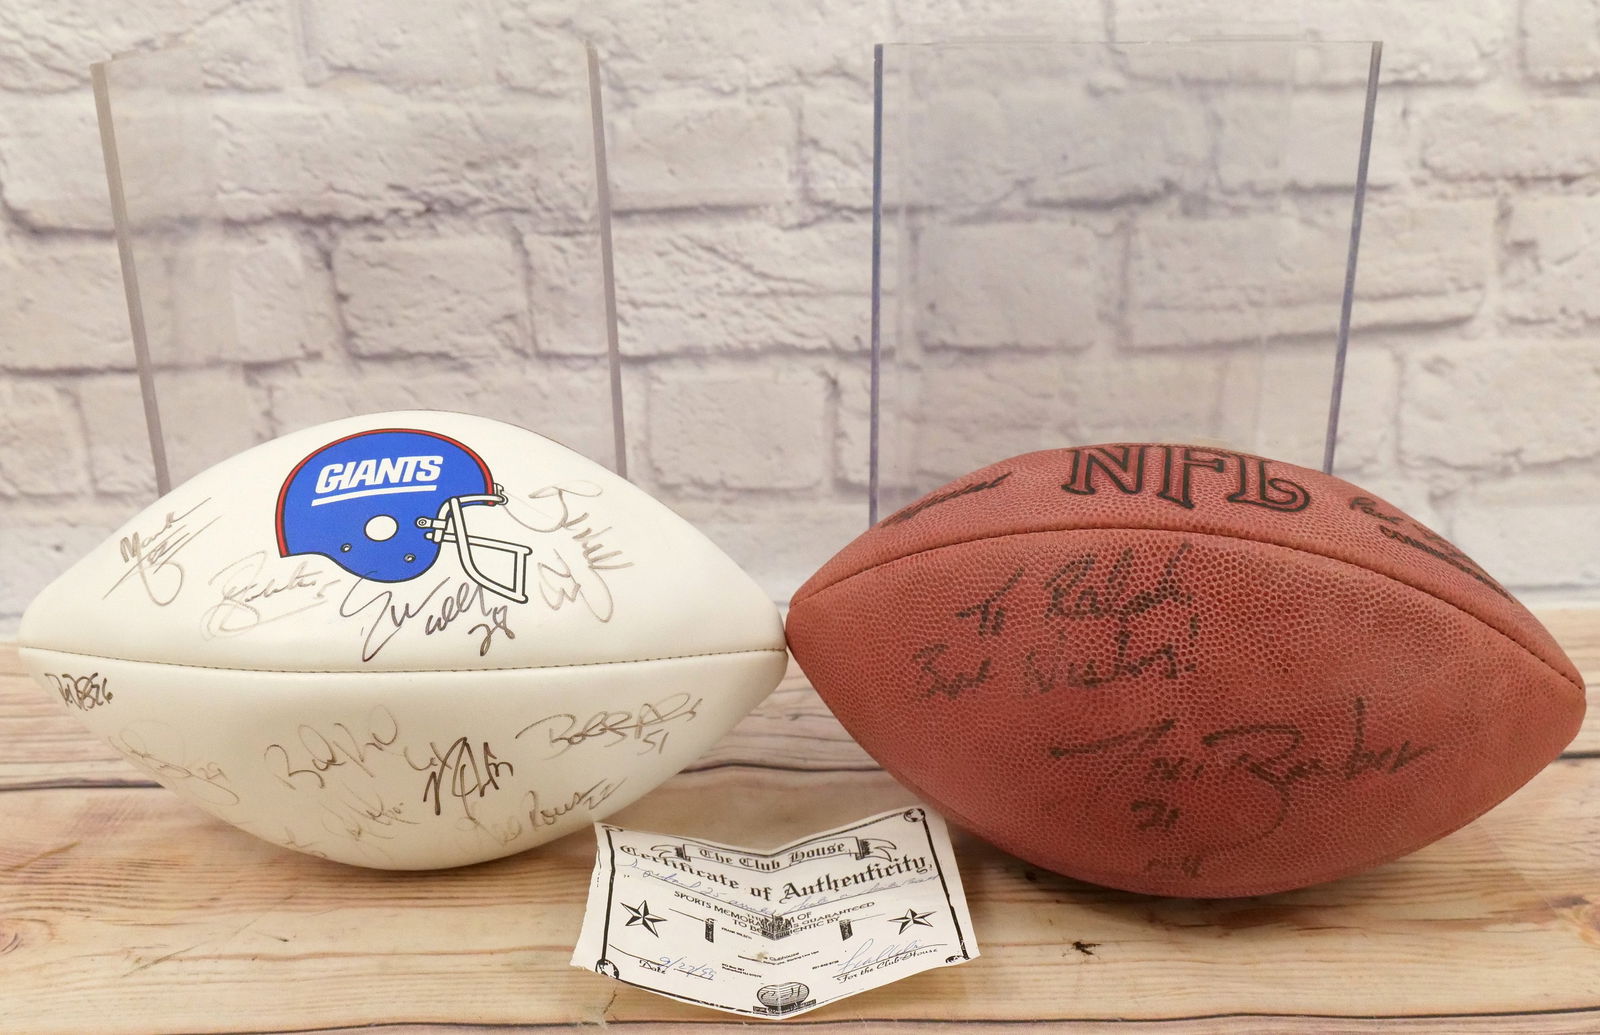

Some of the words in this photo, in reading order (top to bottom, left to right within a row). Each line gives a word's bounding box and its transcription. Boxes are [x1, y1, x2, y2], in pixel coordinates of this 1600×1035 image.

[315, 455, 443, 494] GIANTS
[1061, 445, 1311, 512] NFL
[620, 845, 739, 889] Certificate
[750, 886, 772, 901] of
[699, 847, 733, 865] The
[739, 857, 780, 872] Club
[789, 842, 845, 865] House
[674, 891, 711, 909] SPORTS
[804, 901, 875, 925] GUARANTEED
[733, 918, 747, 928] TO
[827, 914, 841, 925] BY
[796, 911, 812, 922] OF
[639, 959, 666, 975] Date
[837, 971, 858, 984] For
[860, 966, 874, 975] the
[876, 957, 900, 970] Club
[900, 948, 938, 962] House
